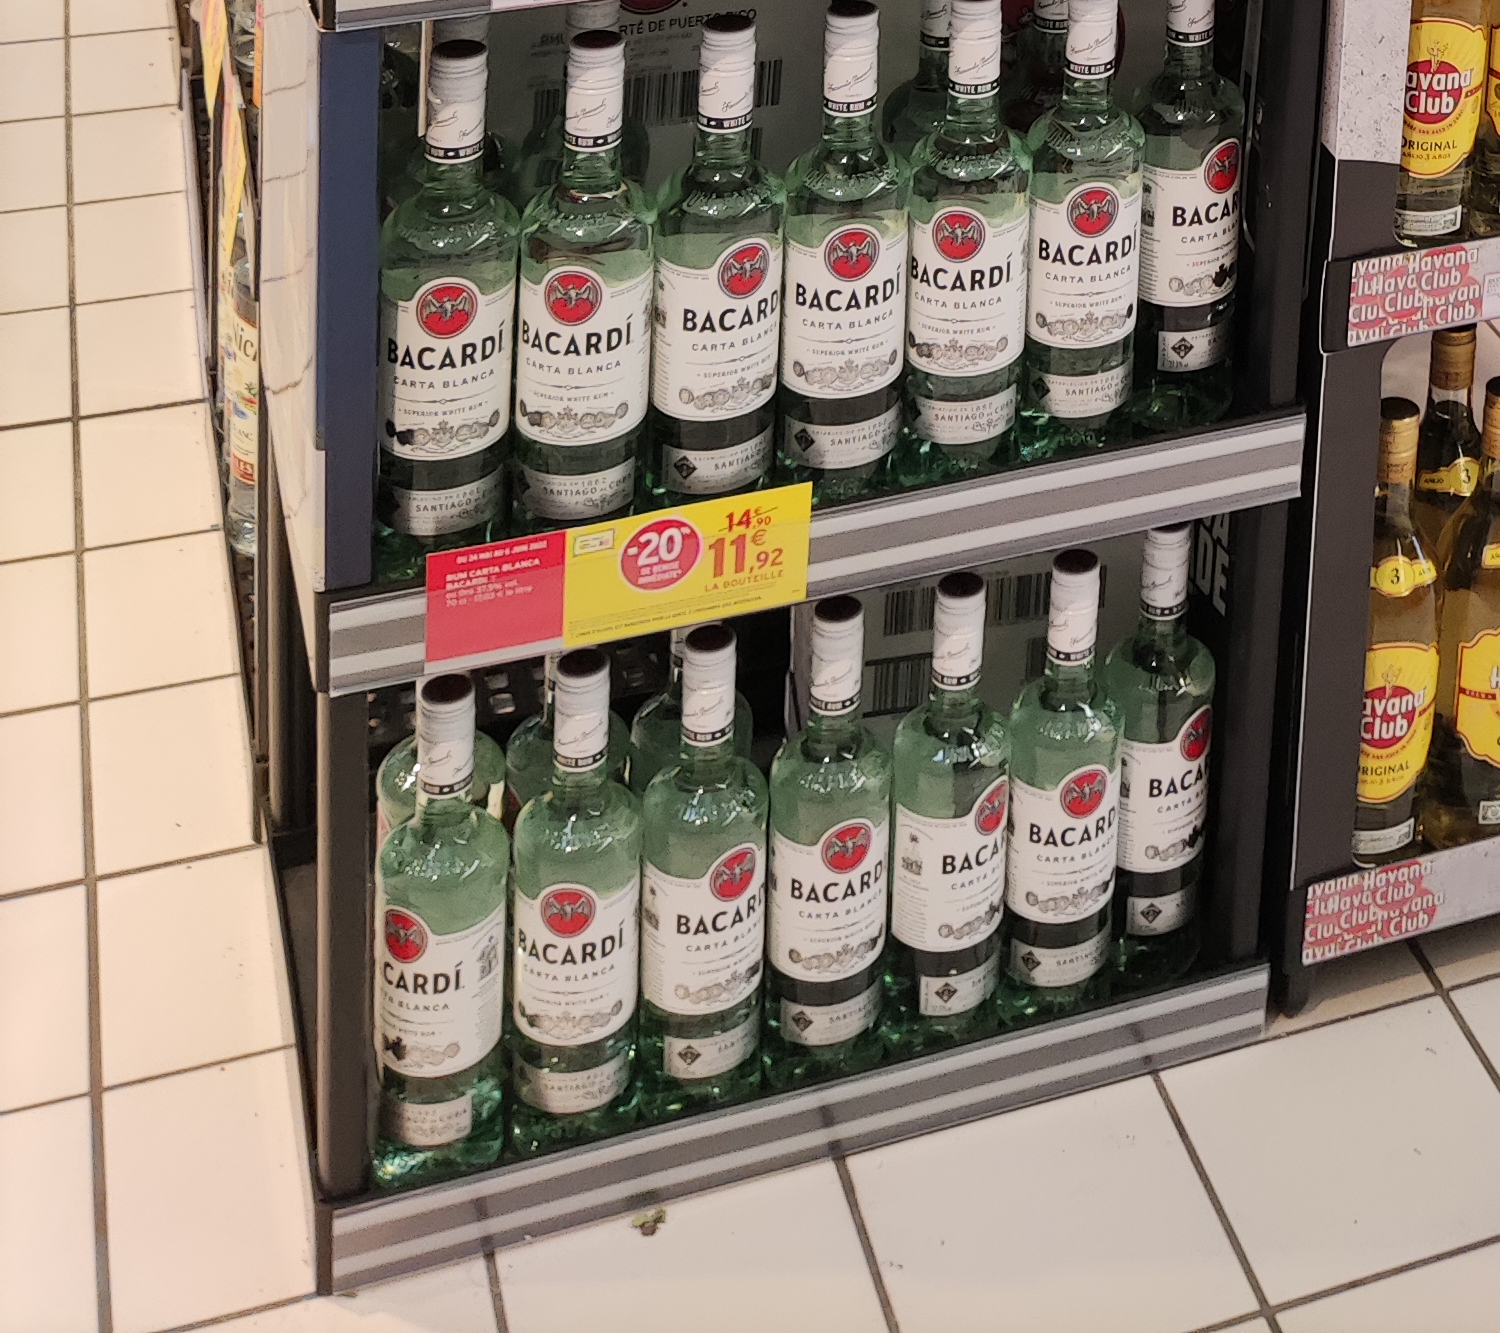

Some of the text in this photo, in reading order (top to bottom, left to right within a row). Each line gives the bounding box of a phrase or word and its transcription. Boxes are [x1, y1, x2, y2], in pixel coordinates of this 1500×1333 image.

[1038, 227, 1139, 266] BACARDÍ
[1045, 265, 1132, 284] CARTA BLANCA
[522, 314, 634, 357] BACARDÍ
[526, 357, 622, 375] CARTA BLANCA
[705, 570, 784, 593] LA BOUTEILLE
[518, 922, 626, 965] BACARDÍ
